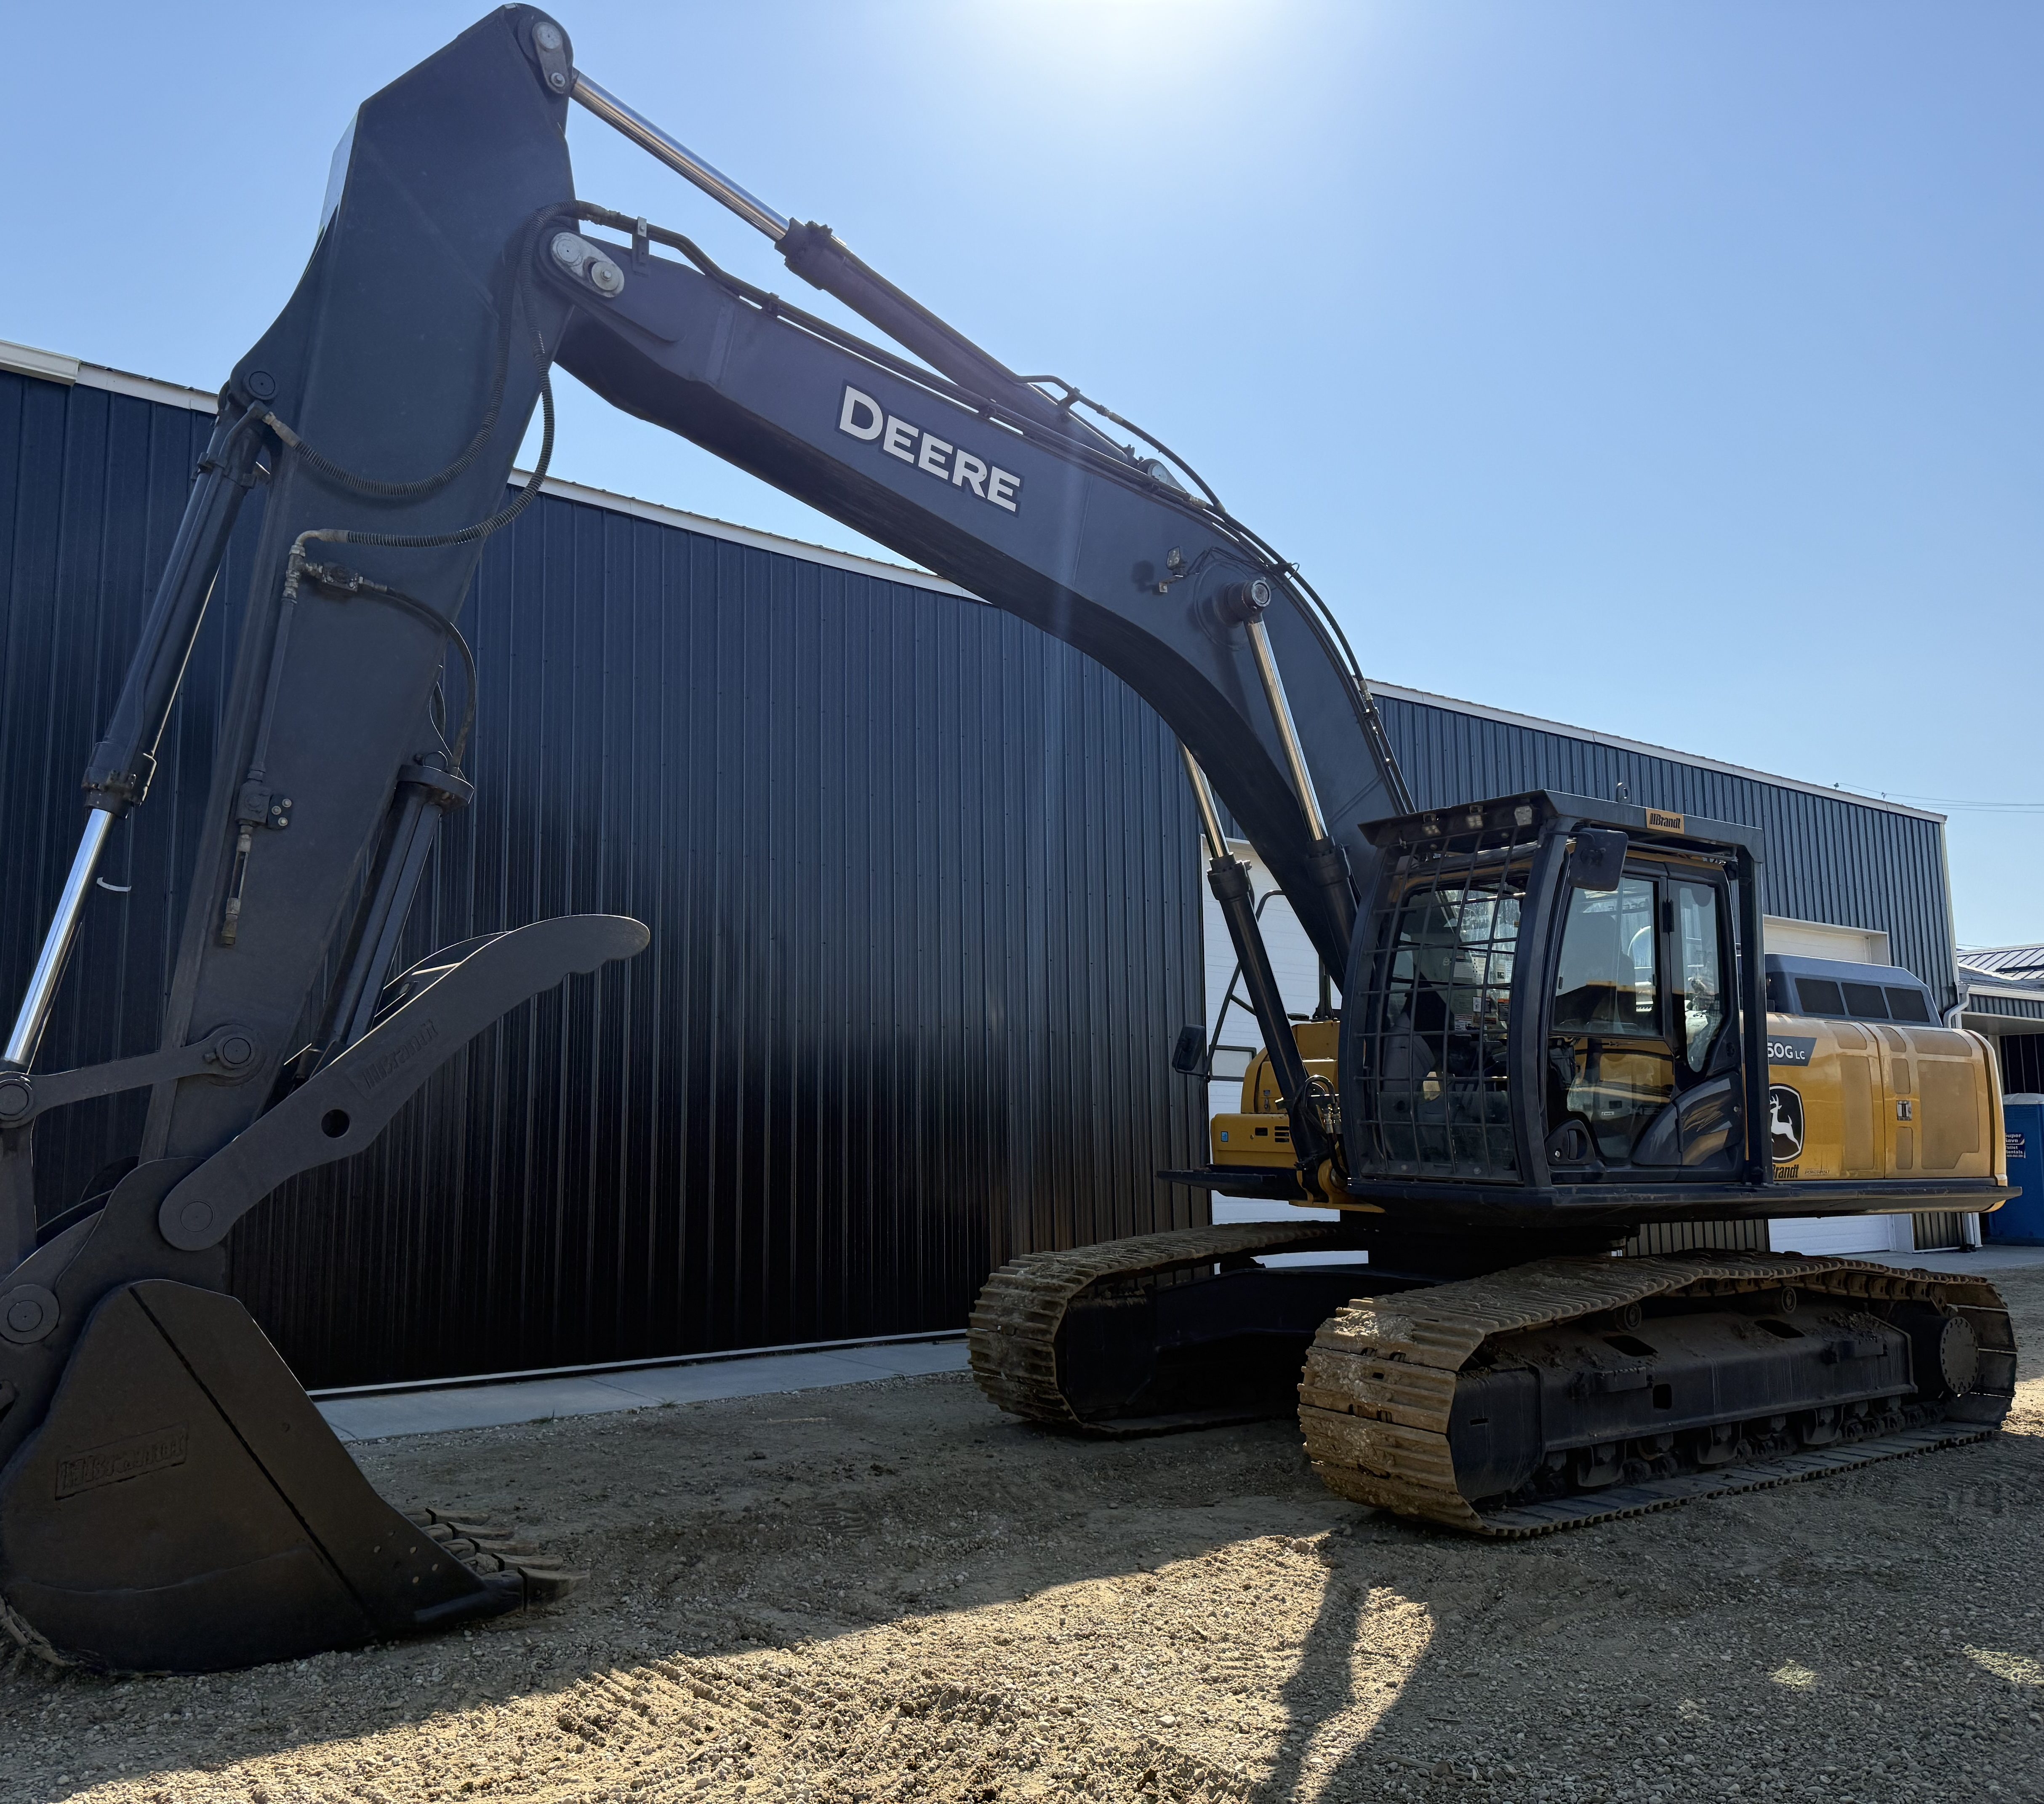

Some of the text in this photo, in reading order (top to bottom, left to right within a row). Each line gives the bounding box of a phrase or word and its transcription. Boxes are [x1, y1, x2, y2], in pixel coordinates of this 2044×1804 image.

[839, 385, 1021, 512] DEERE
[1655, 813, 1681, 829] Brandt
[1795, 1050, 1805, 1060] LC
